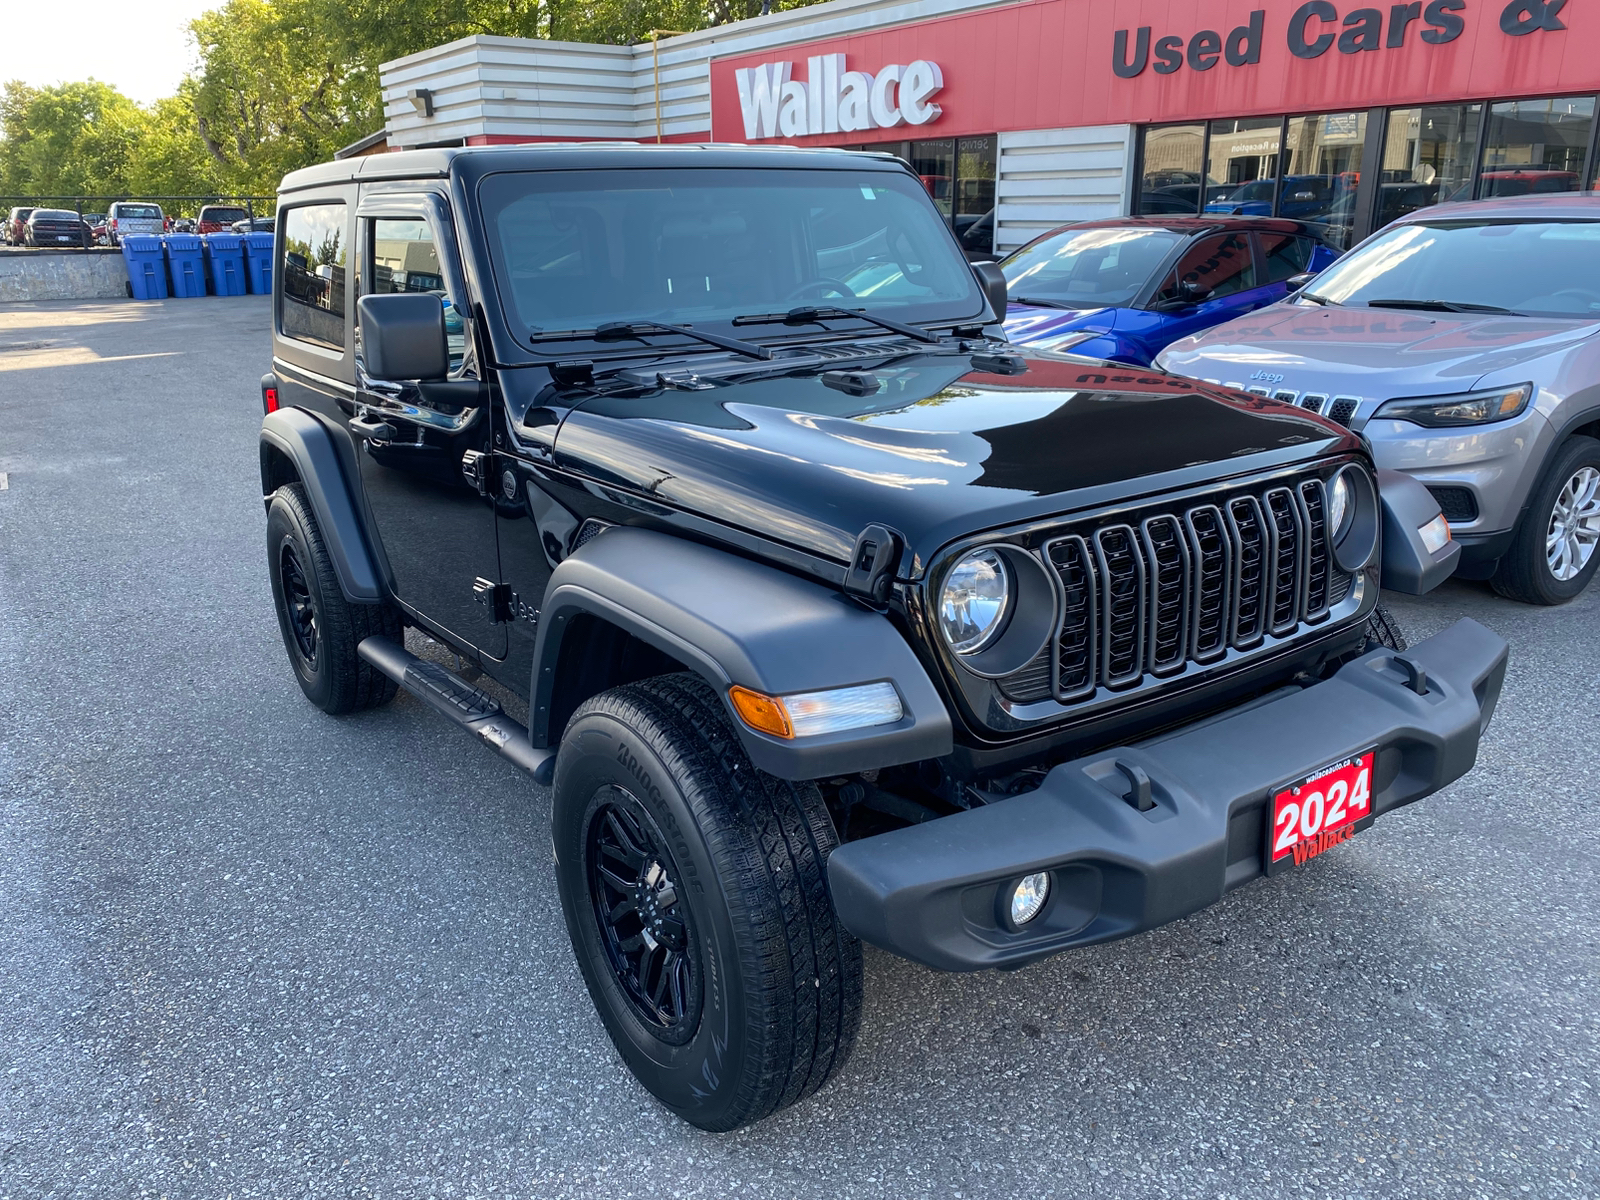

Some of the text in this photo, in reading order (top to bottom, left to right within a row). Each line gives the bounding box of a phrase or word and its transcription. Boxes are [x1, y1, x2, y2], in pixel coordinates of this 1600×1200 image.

[1112, 10, 1265, 78] Used
[1287, 0, 1466, 59] Cars
[735, 53, 944, 140] Wallace
[1250, 369, 1285, 384] Jeep
[508, 592, 542, 624] Jee
[1306, 759, 1351, 784] wallaceauto.ca
[616, 742, 706, 896] BRIDGESTONE
[1275, 768, 1370, 853] 2024
[1291, 823, 1355, 867] Wallace
